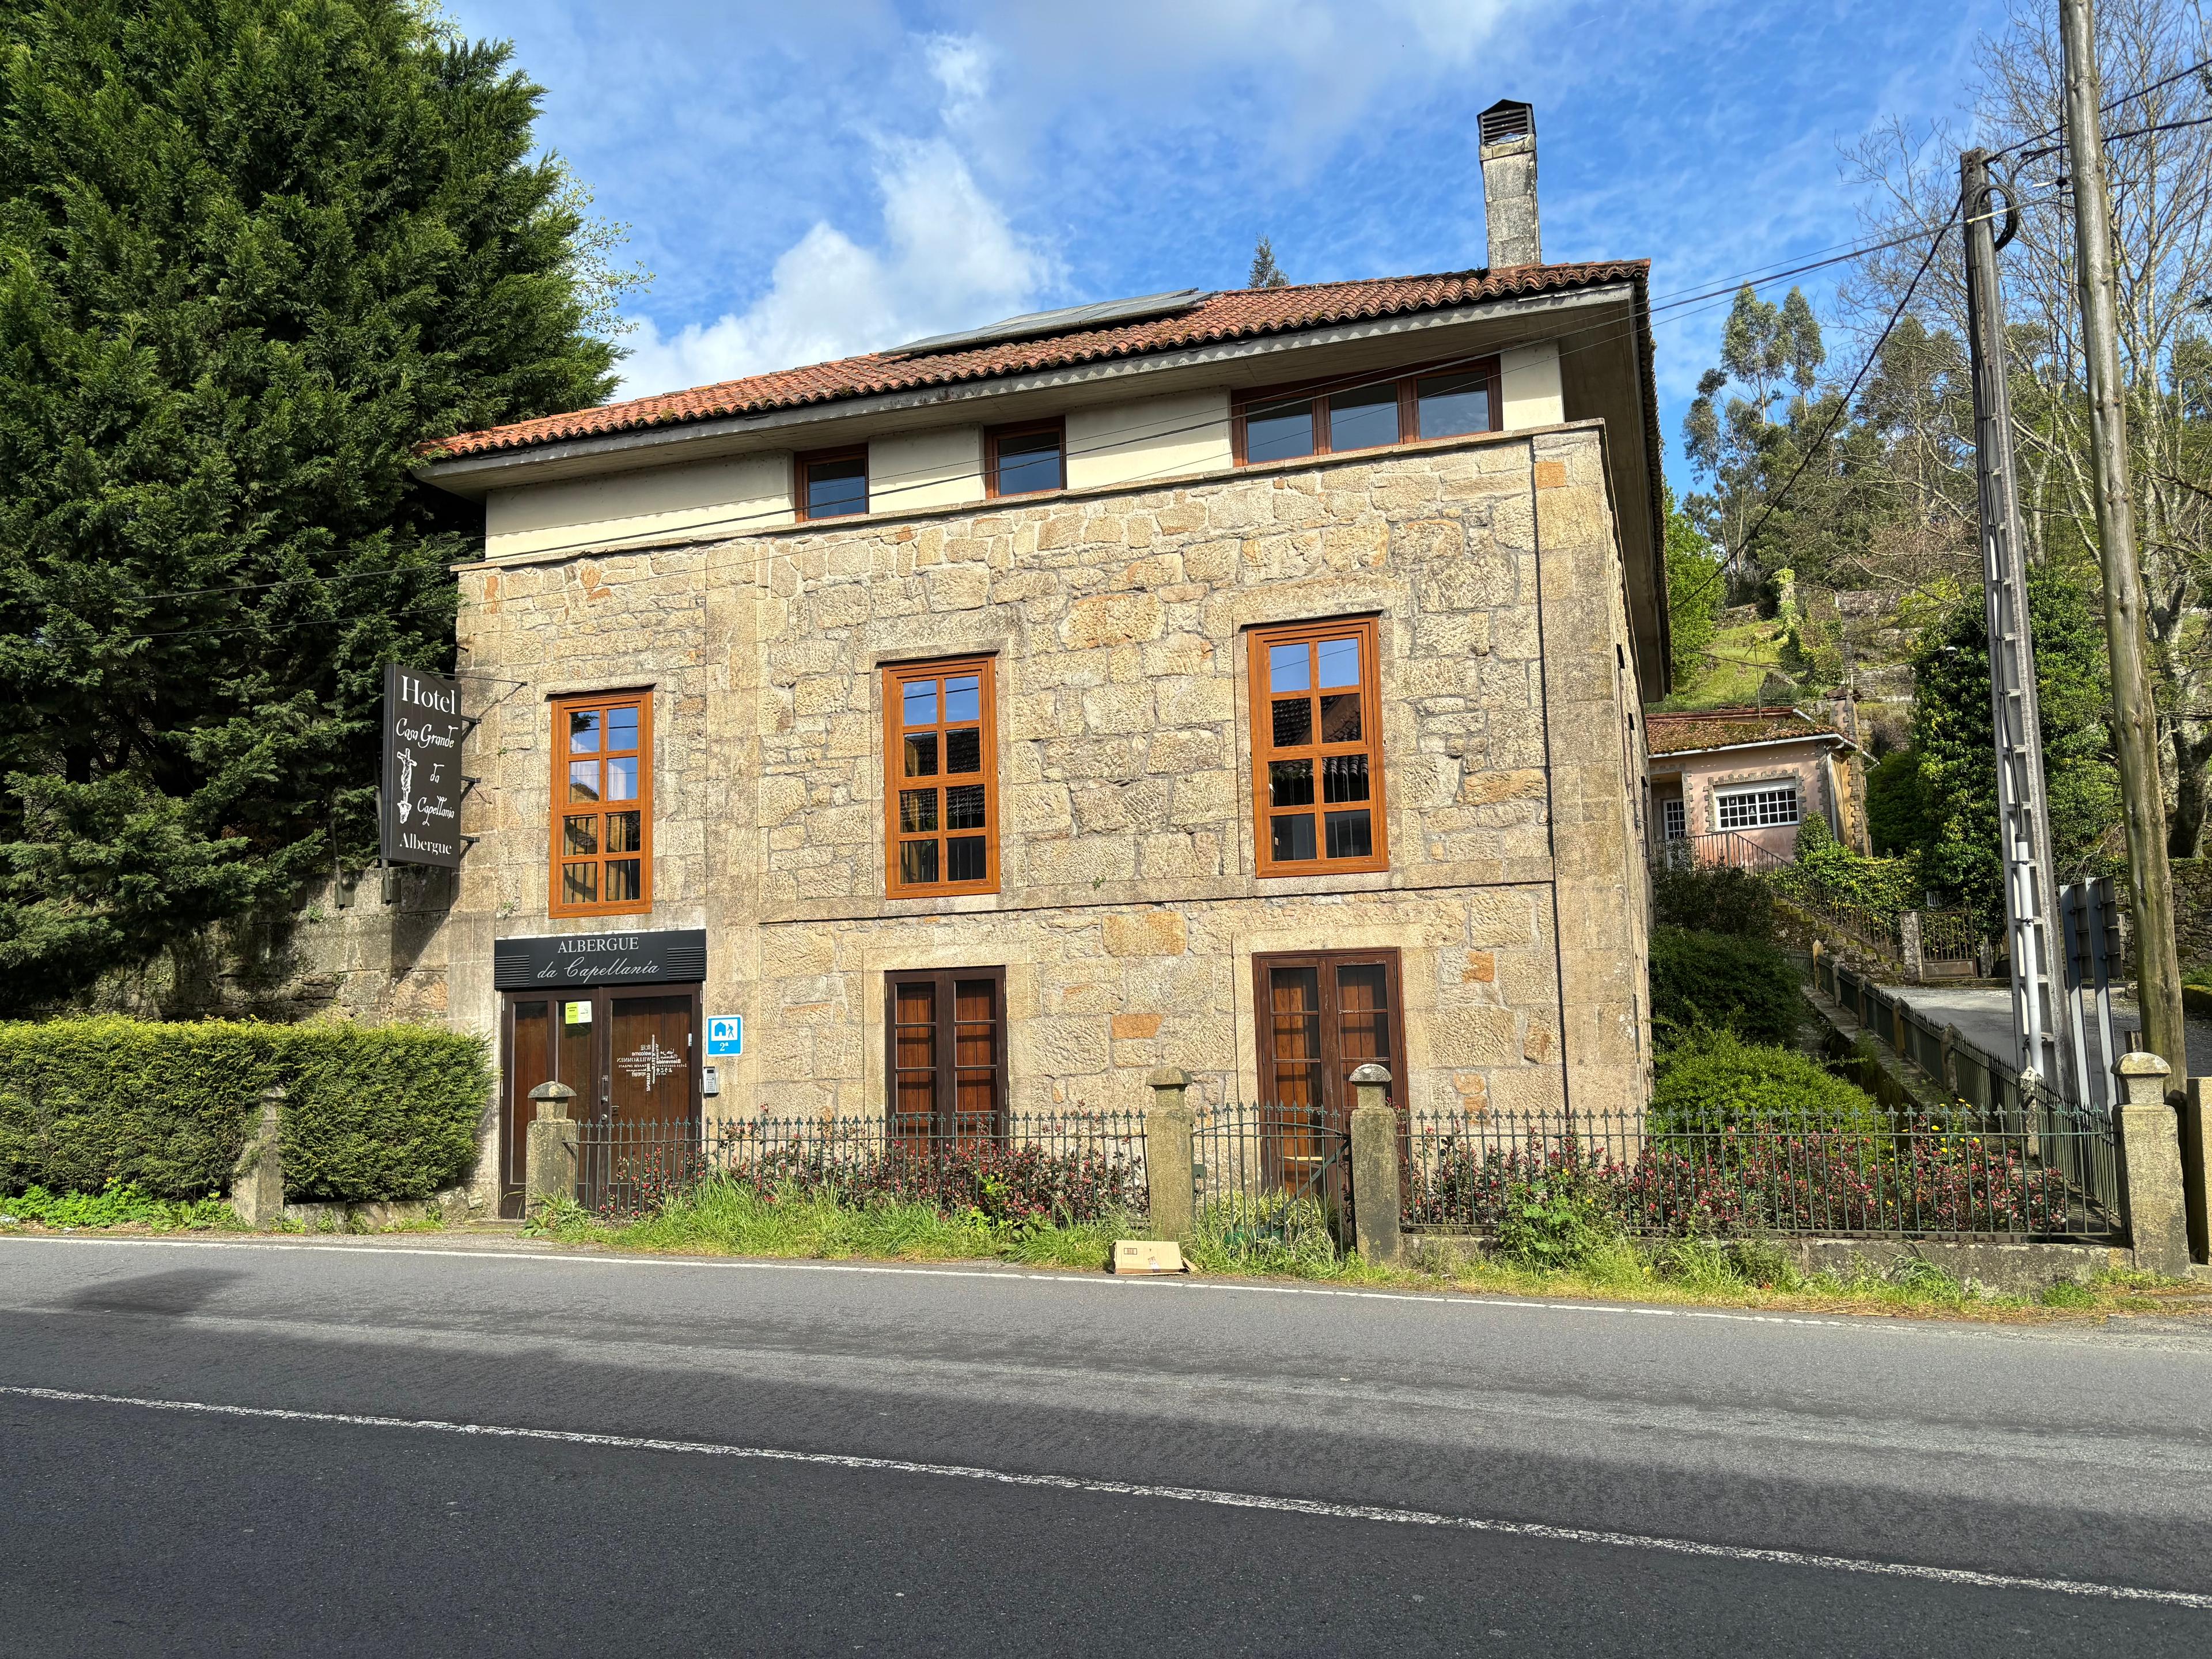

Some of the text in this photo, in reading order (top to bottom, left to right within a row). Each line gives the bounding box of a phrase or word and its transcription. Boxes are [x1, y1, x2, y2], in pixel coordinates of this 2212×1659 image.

[401, 675, 455, 715] Hotel
[396, 718, 459, 748] Casa Grande
[430, 763, 445, 783] da
[399, 832, 452, 855] Albergue
[557, 937, 639, 953] ALBERGUE
[537, 961, 558, 979] da
